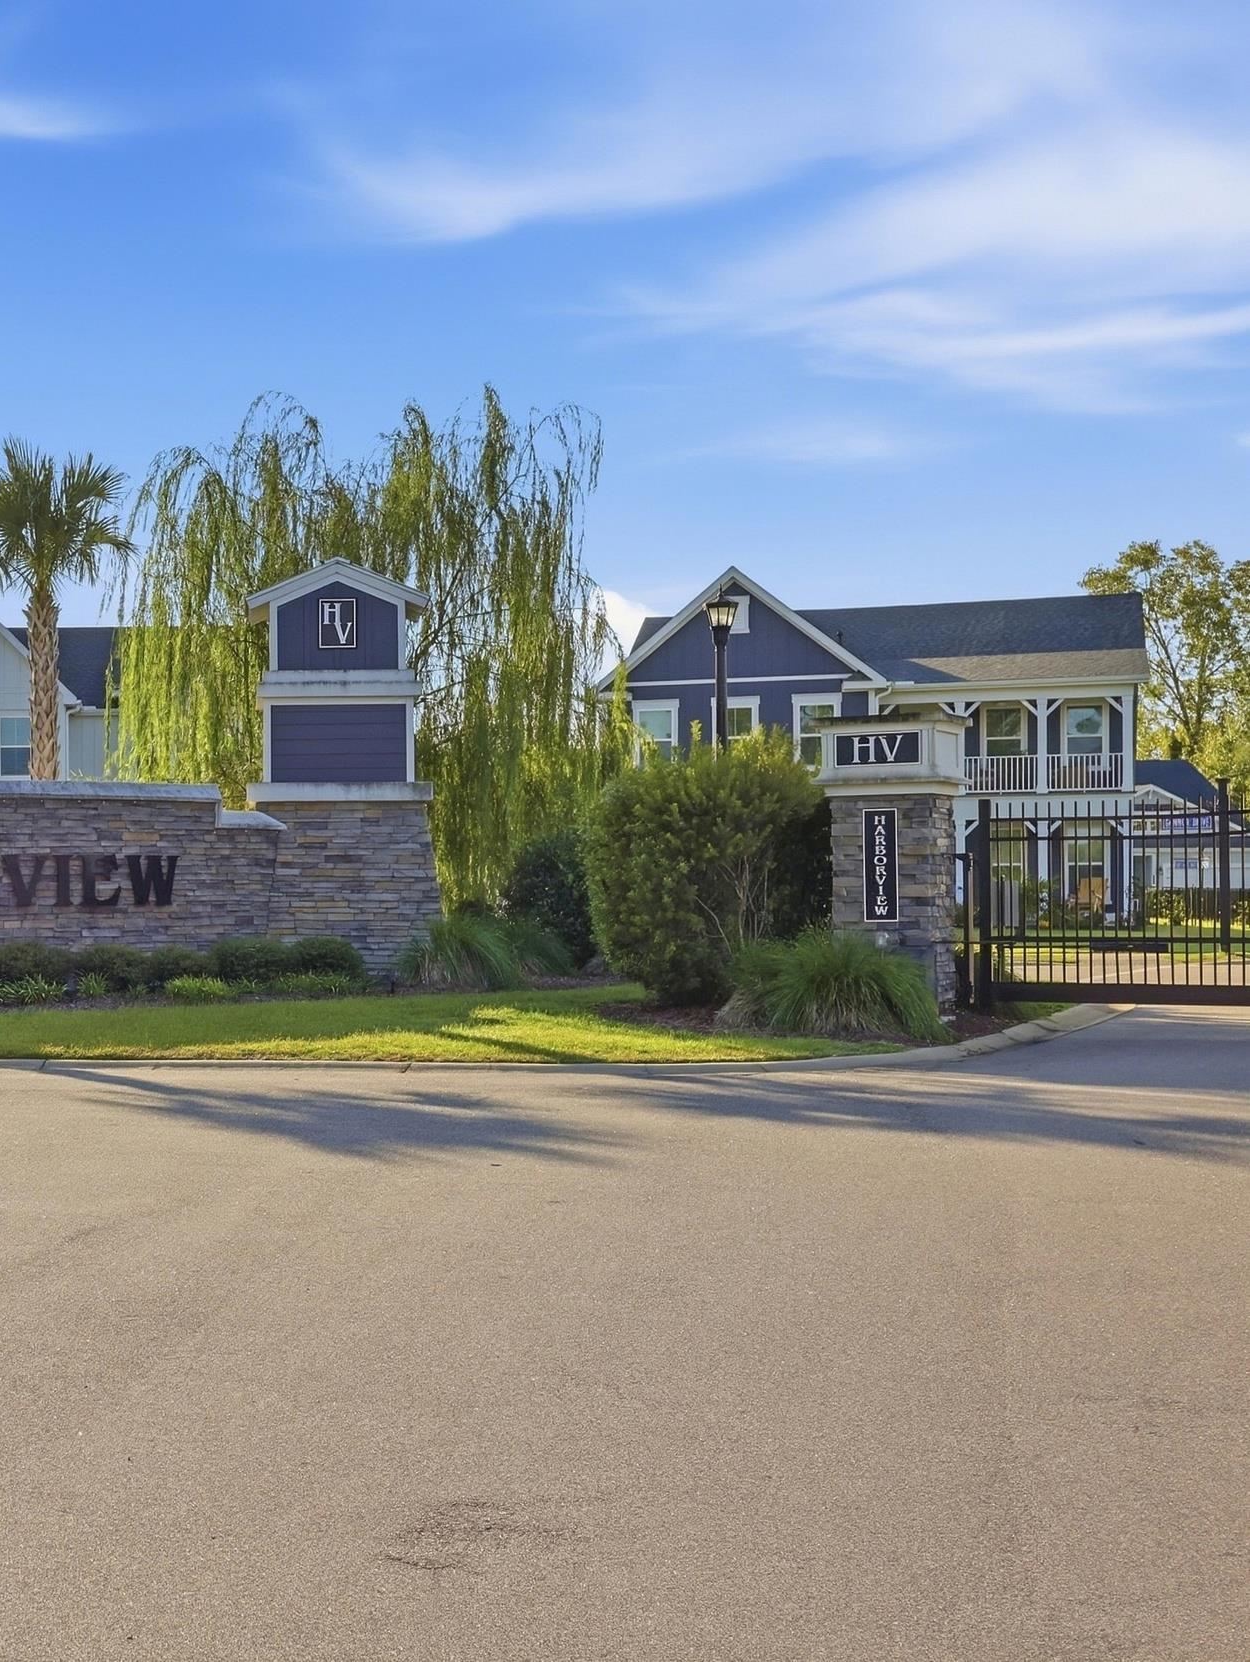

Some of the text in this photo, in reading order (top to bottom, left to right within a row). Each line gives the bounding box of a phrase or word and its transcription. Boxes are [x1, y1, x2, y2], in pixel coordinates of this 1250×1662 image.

[322, 602, 352, 644] HV
[851, 734, 903, 763] HV
[874, 815, 888, 916] HARBORVIEW
